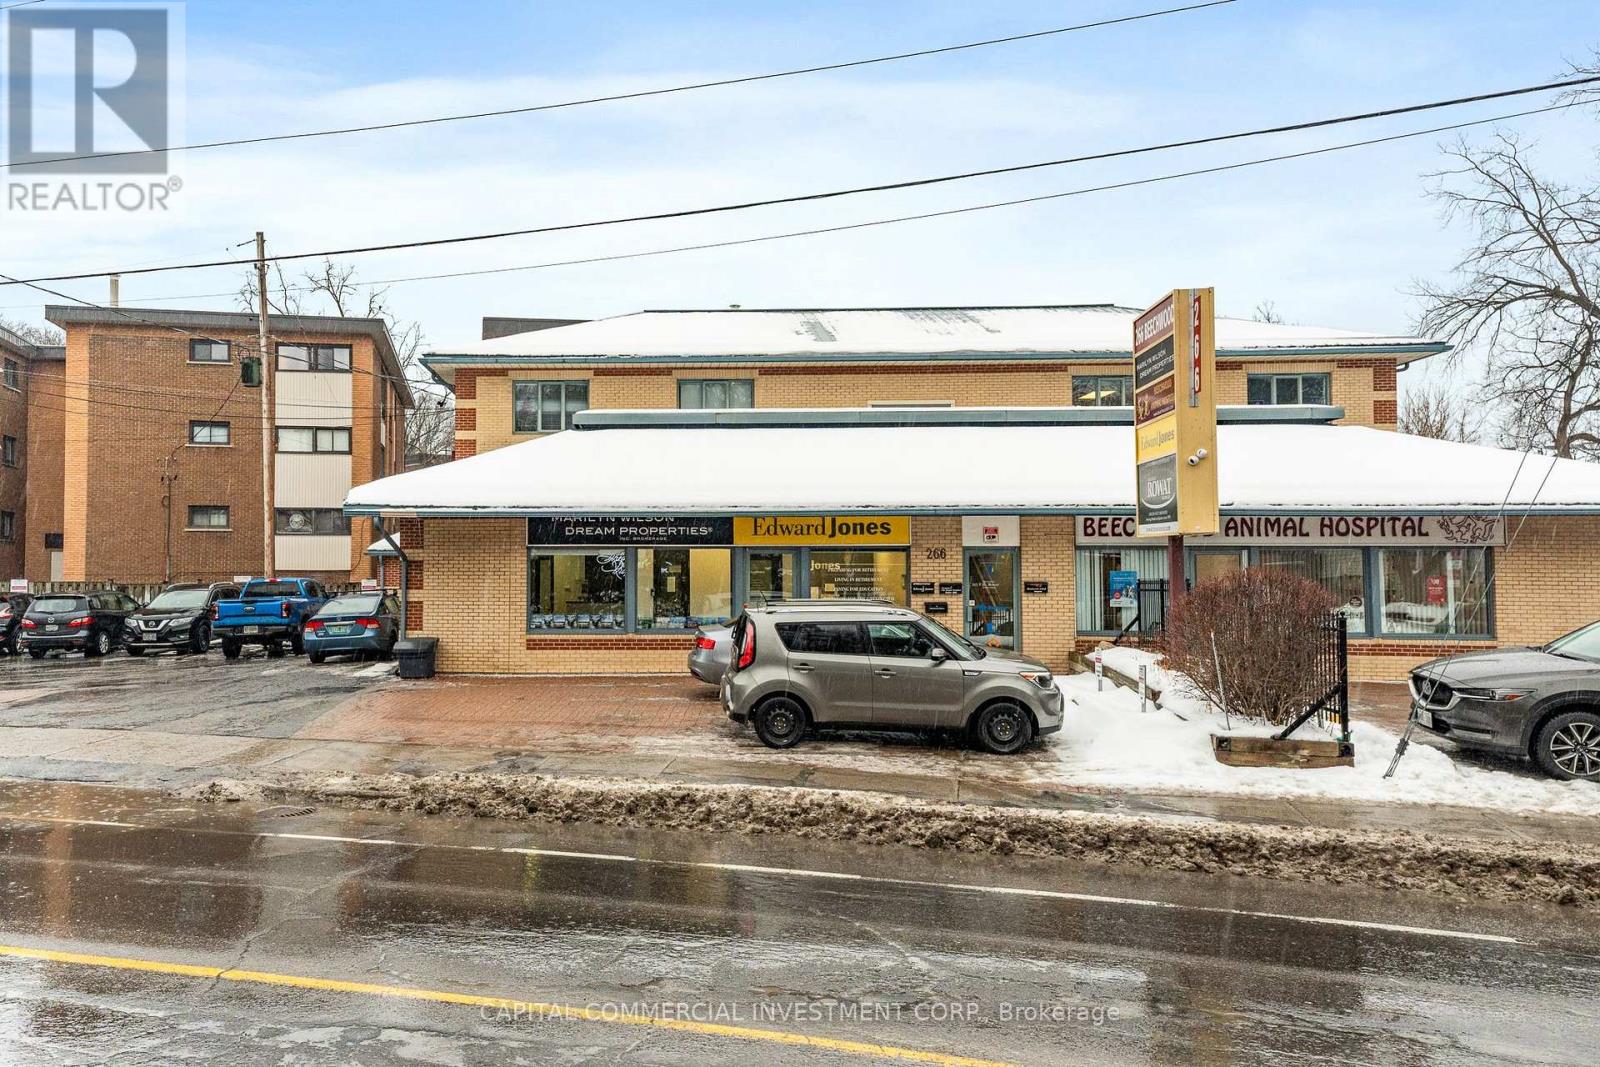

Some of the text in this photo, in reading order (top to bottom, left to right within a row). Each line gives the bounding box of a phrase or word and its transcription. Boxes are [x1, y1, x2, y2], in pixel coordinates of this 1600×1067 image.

[1147, 477, 1172, 498] ROWAT
[565, 526, 615, 536] DREAM
[751, 516, 892, 538] Edward Jones
[1224, 517, 1310, 537] ANIMAL
[1319, 516, 1430, 537] HOSPITAL
[926, 547, 947, 560] 266
[809, 559, 841, 571] Jones
